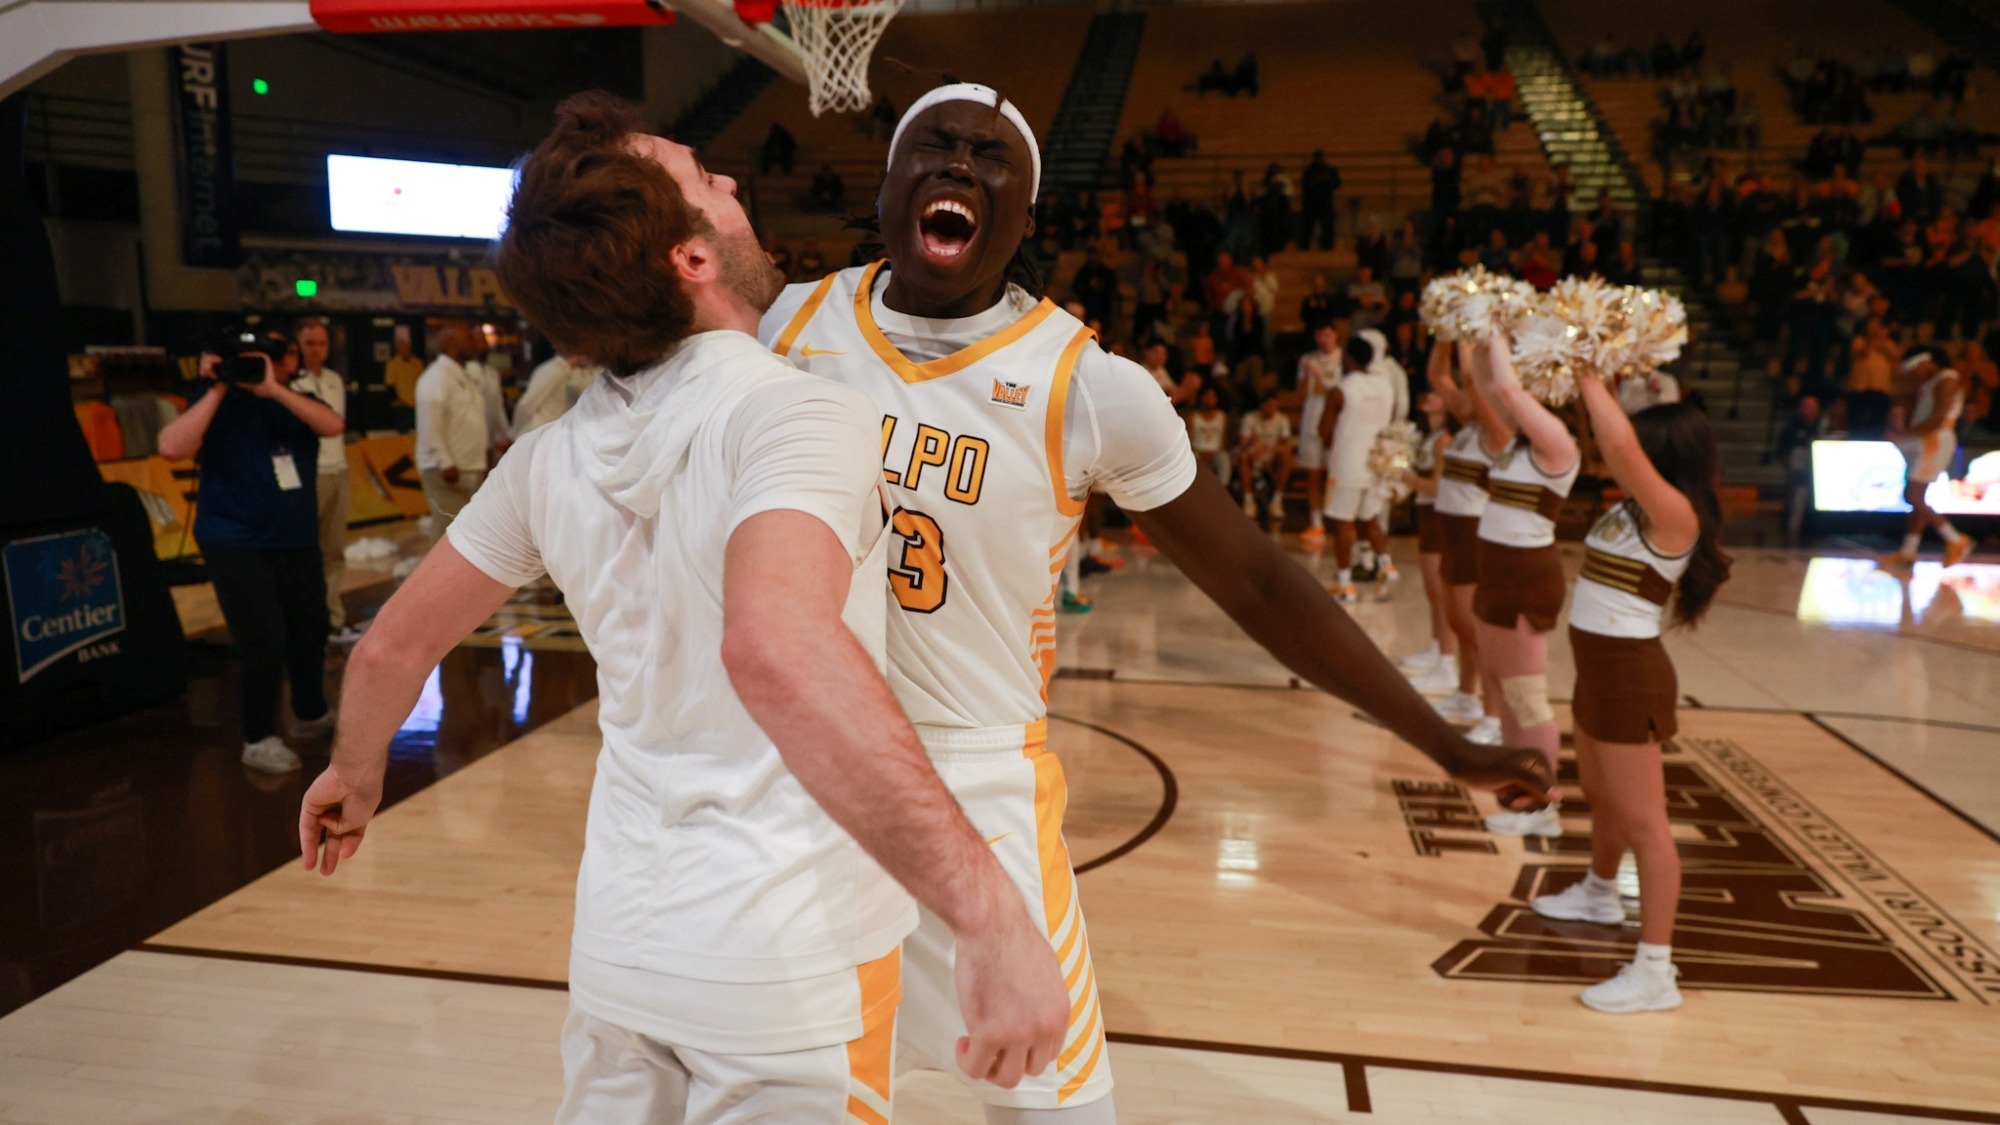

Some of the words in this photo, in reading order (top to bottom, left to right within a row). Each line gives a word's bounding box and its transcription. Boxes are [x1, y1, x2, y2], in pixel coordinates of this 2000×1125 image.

[992, 379, 1030, 403] VALLEY
[882, 414, 989, 506] LPO
[22, 604, 117, 642] Centier
[78, 641, 120, 664] BANK
